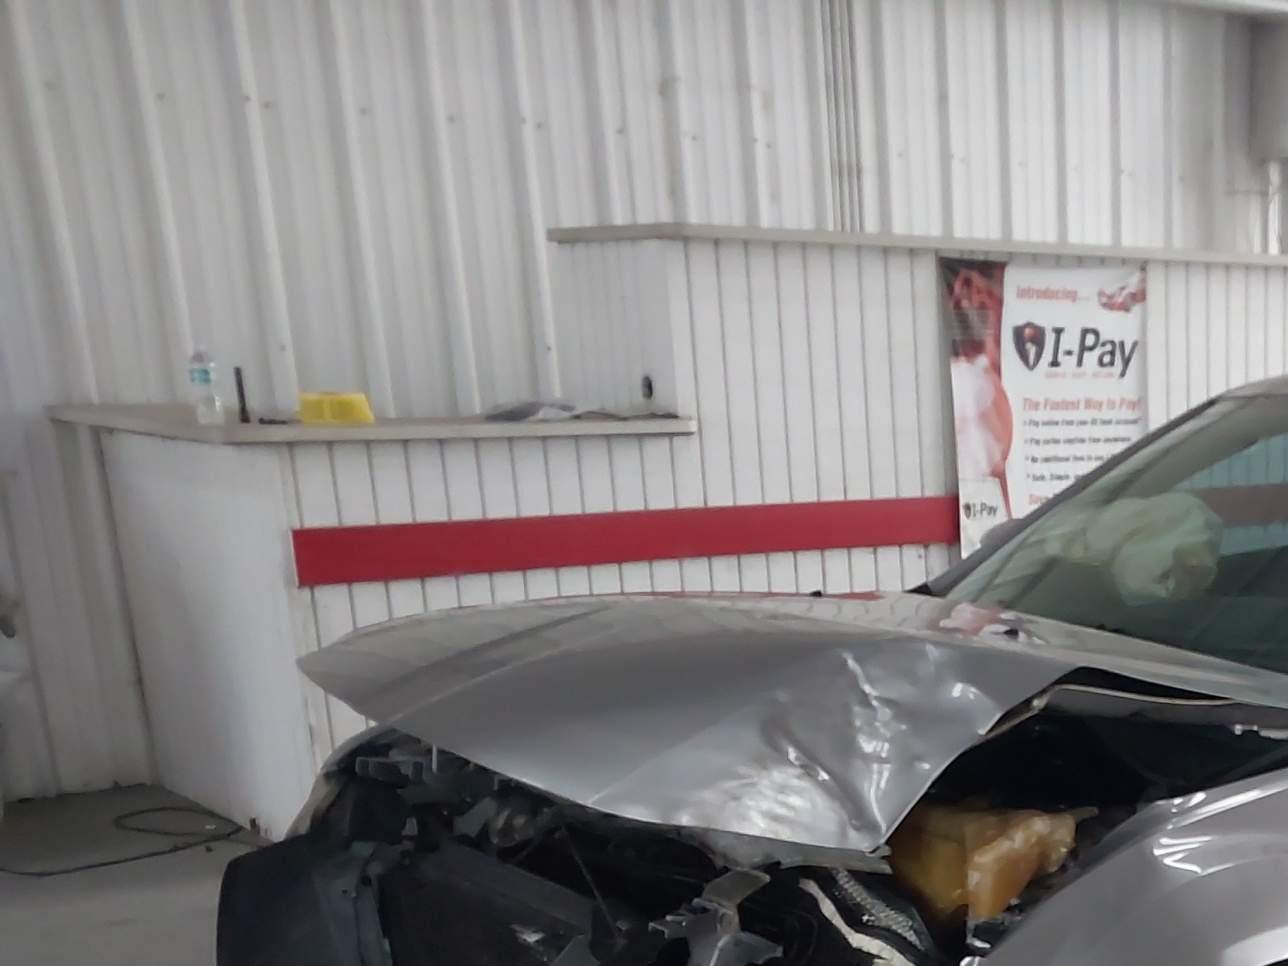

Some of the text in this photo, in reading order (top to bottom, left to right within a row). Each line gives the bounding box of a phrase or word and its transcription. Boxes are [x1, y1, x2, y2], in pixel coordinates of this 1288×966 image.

[1048, 326, 1138, 379] I-Pay
[1023, 397, 1041, 411] The
[1084, 398, 1104, 412] Way
[972, 502, 998, 518] I-Pay
